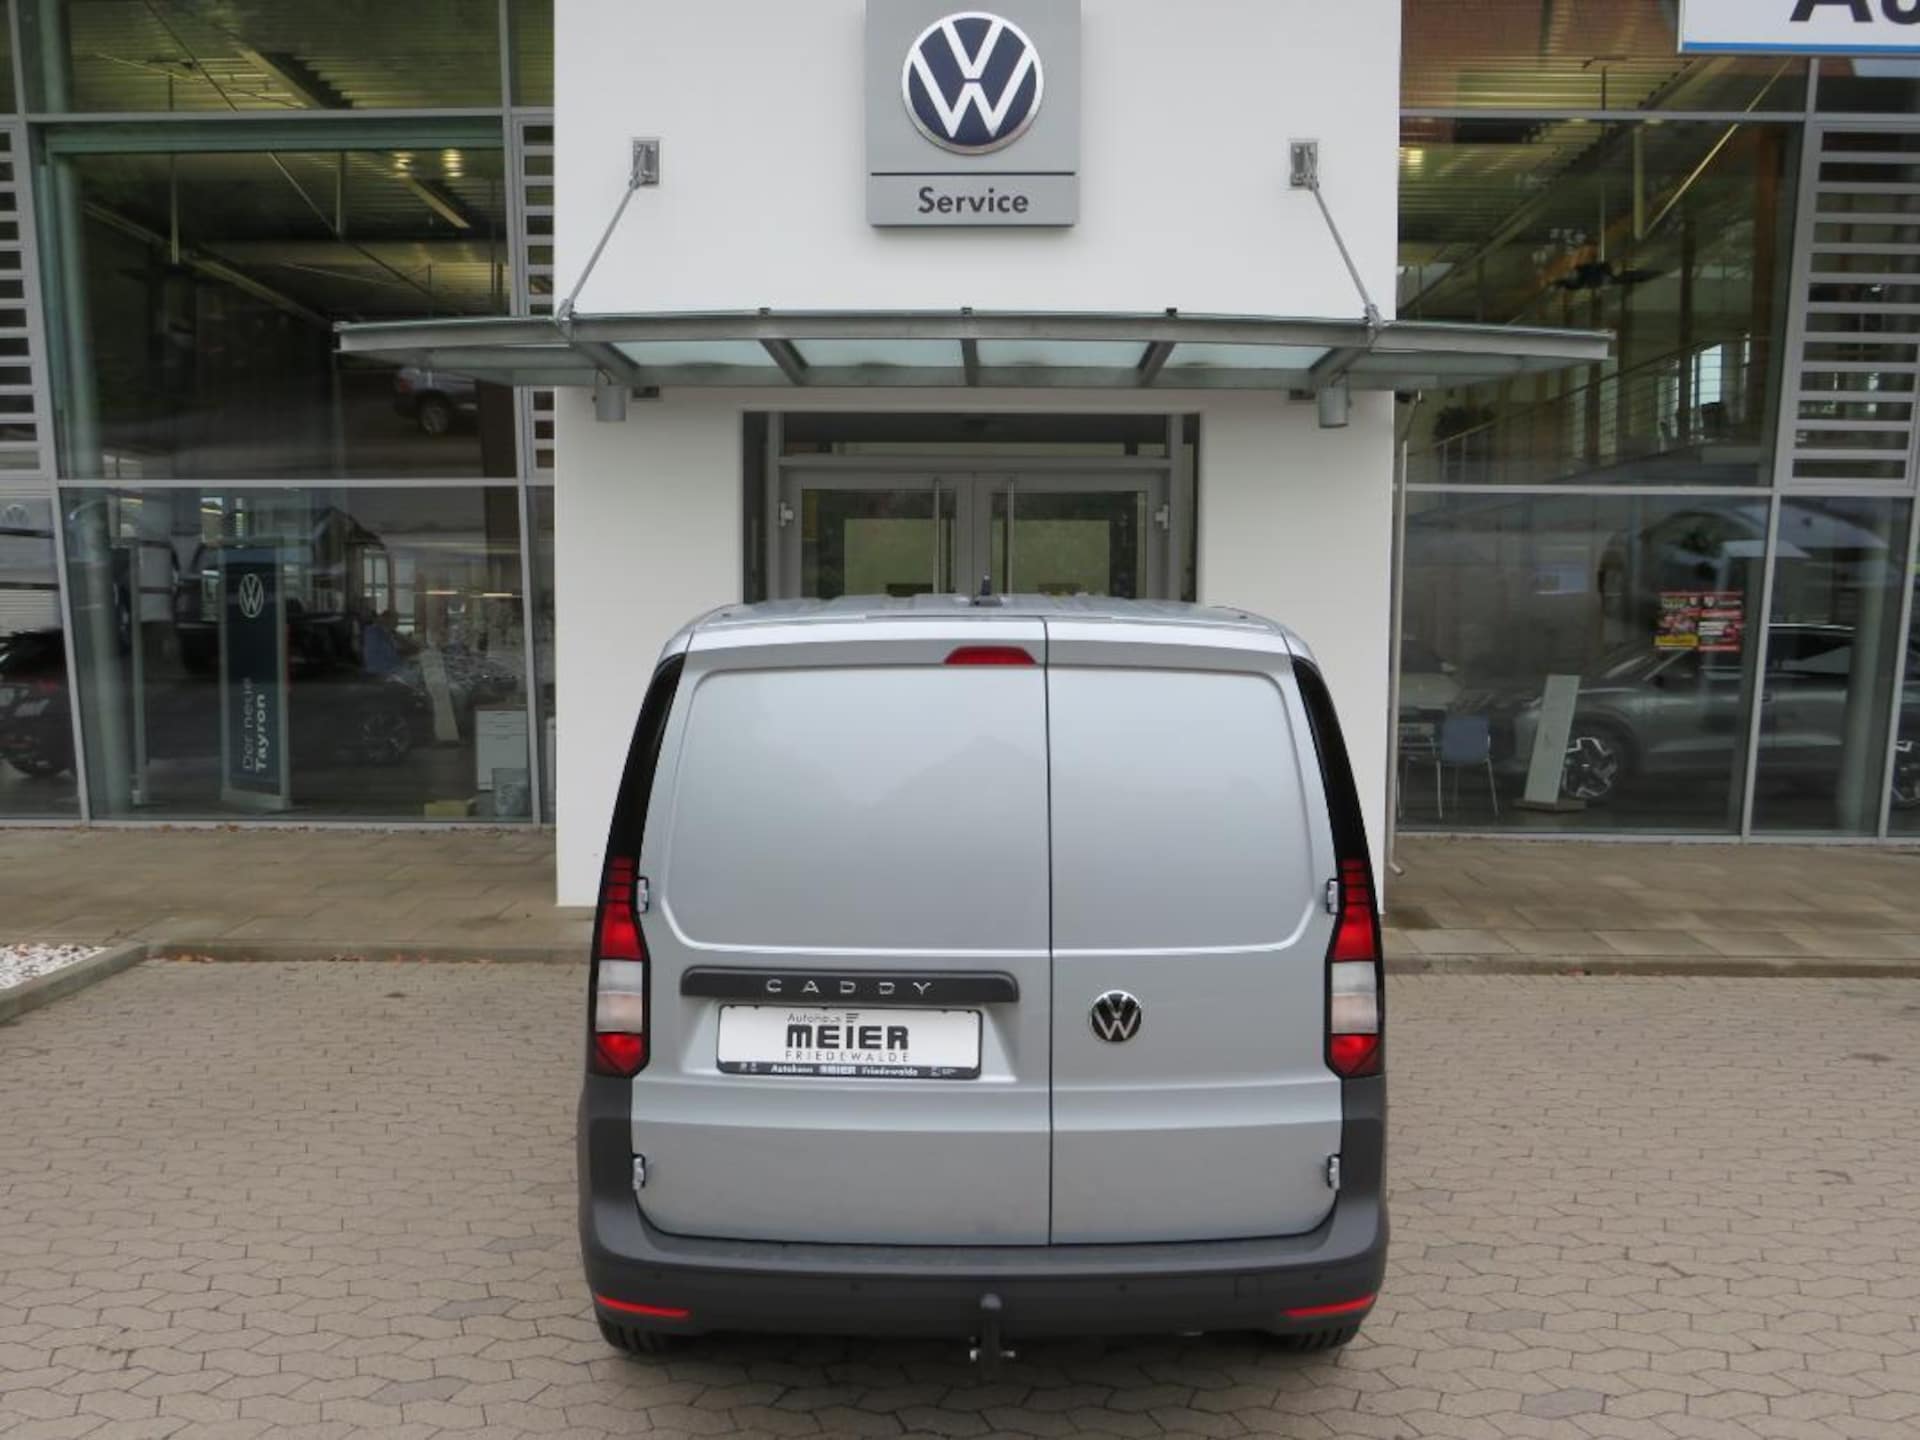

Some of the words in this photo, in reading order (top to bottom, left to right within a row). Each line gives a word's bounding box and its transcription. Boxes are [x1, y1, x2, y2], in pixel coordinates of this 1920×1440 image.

[917, 186, 1029, 213] Service
[255, 694, 270, 773] Tayron
[242, 735, 254, 769] Der
[766, 979, 931, 995] CADDY
[786, 1024, 909, 1050] MEIER
[785, 1051, 910, 1063] FRIEDEWALDE
